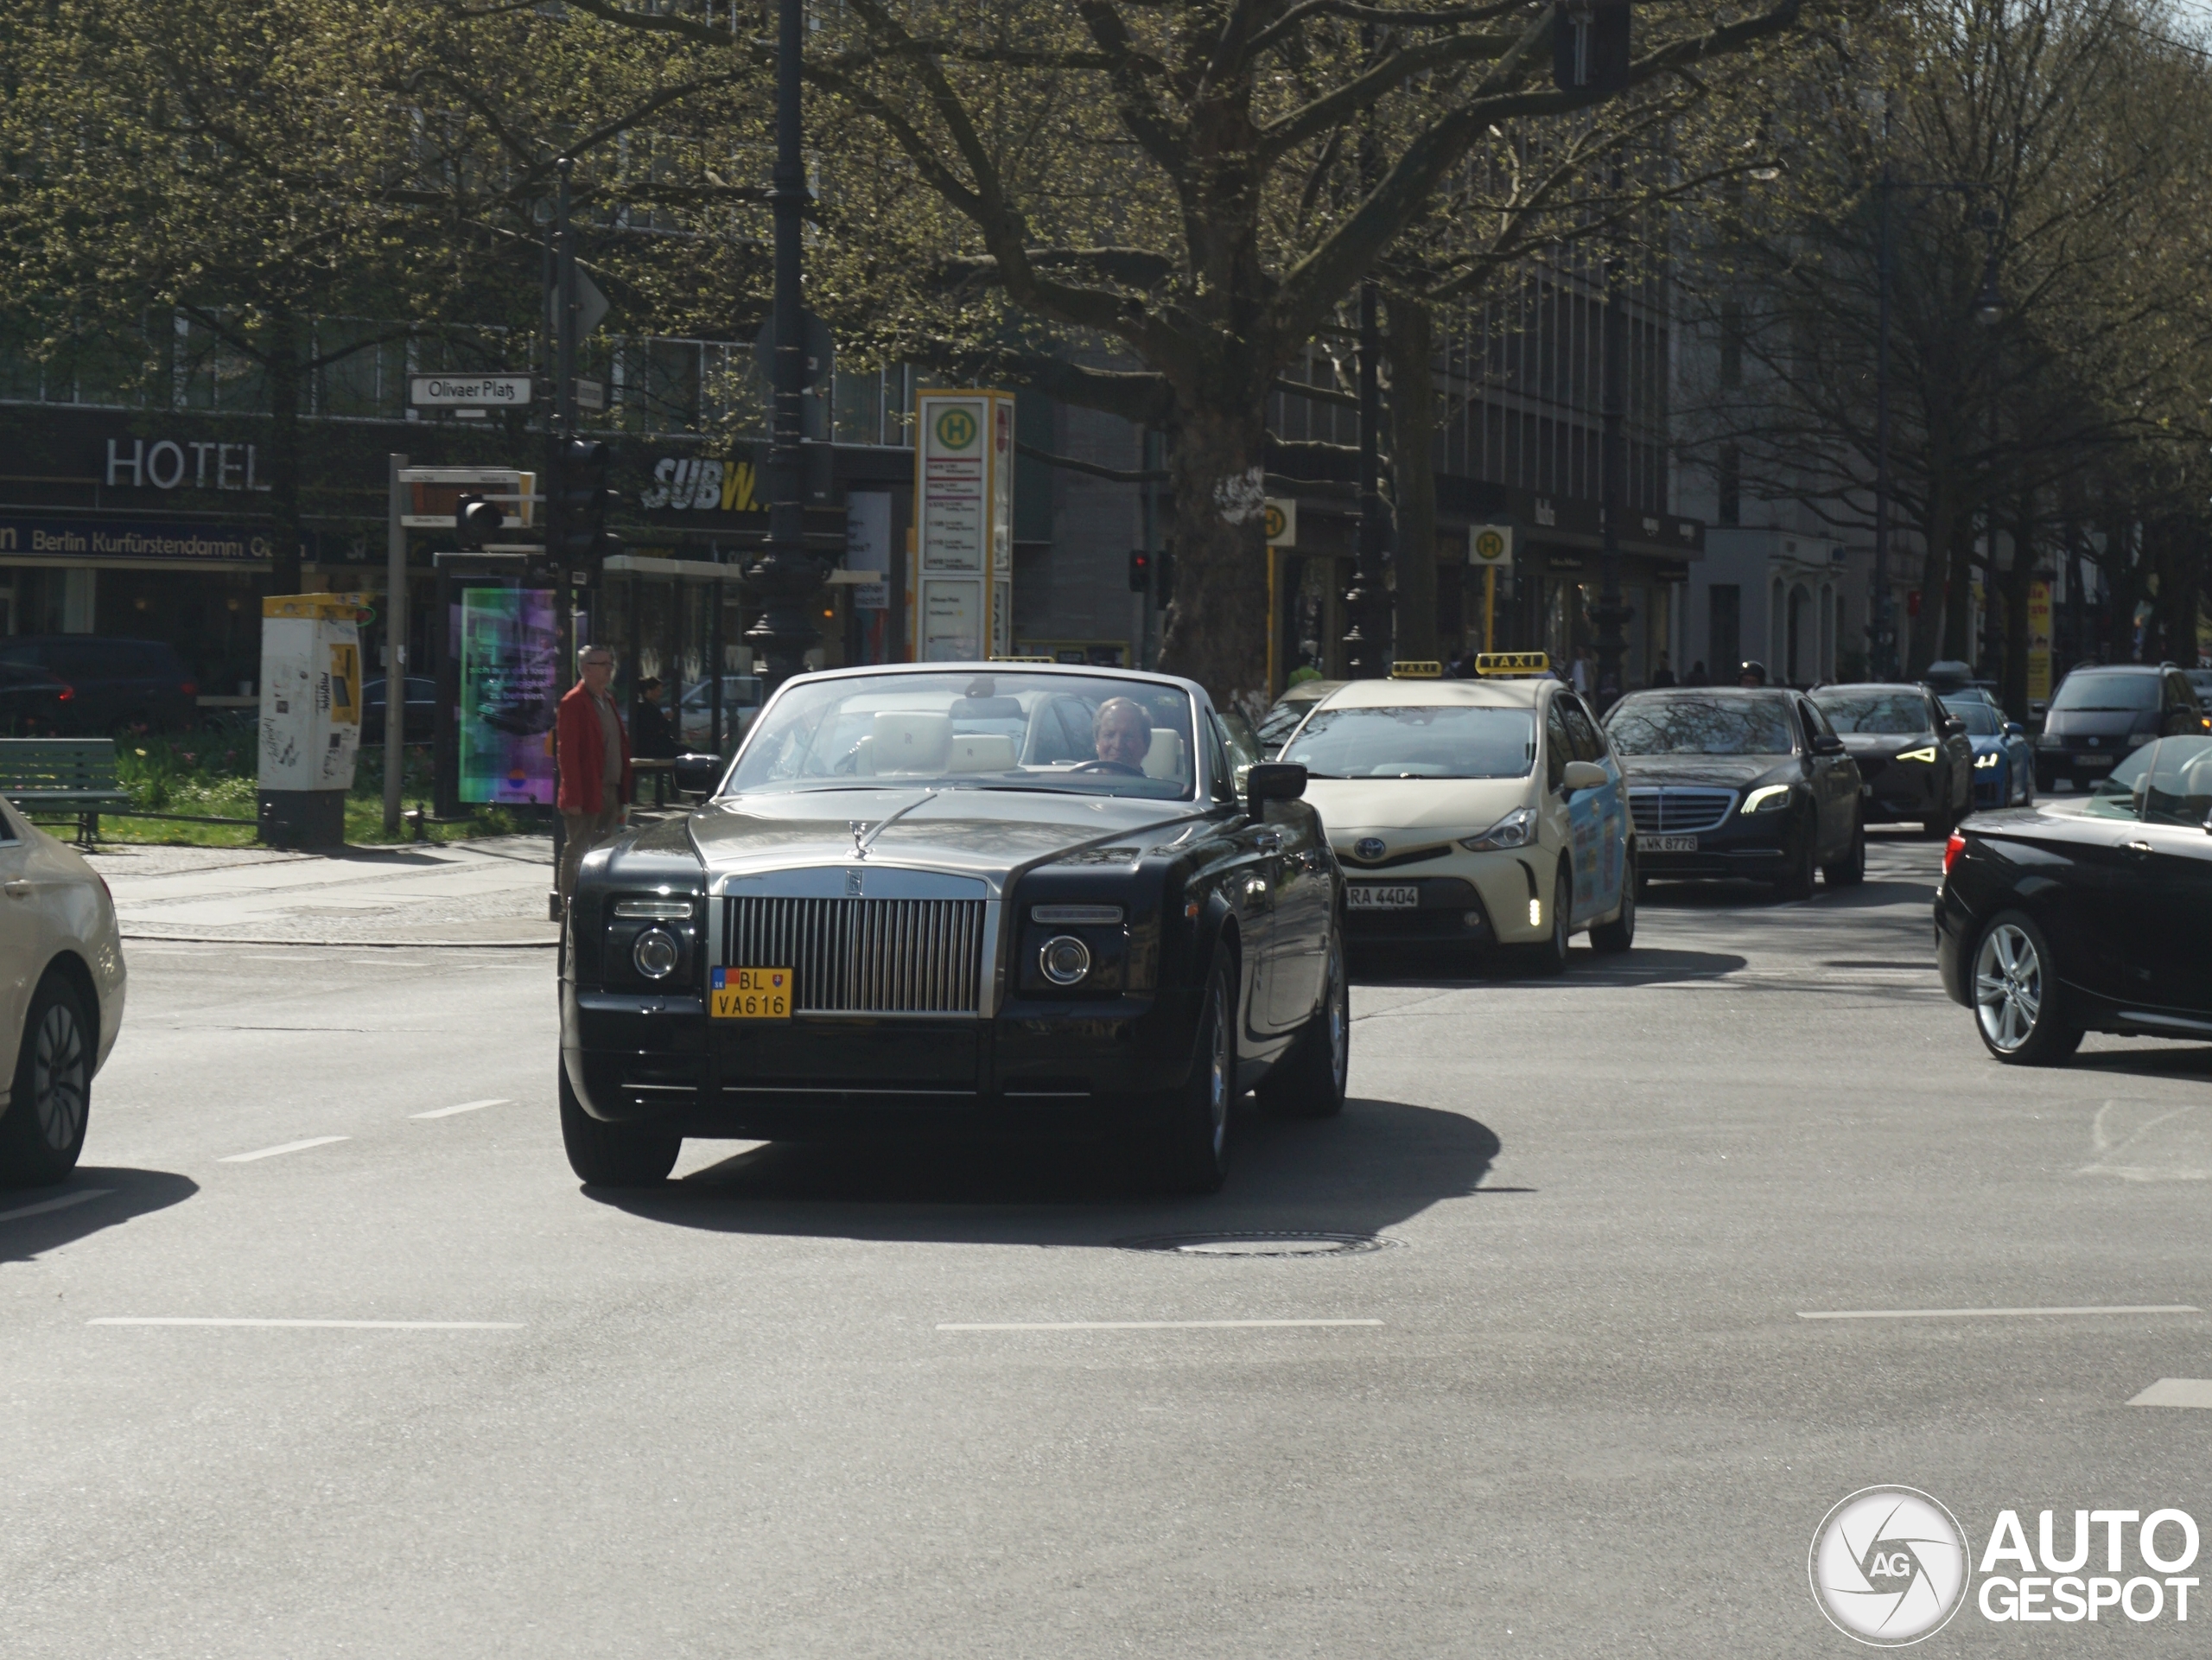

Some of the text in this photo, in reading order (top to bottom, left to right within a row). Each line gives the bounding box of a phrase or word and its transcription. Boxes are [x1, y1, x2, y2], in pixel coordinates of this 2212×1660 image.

[429, 381, 515, 399] Olivaer Platz
[947, 417, 965, 440] H
[106, 438, 272, 492] HOTEL
[640, 458, 772, 512] SUBW
[32, 529, 86, 554] Berlin
[92, 531, 244, 558] Kurfürstendamm
[1484, 539, 1497, 550] H
[1400, 664, 1433, 672] TAXI
[1486, 655, 1536, 666] TAXI
[1665, 837, 1695, 849] 8778
[1376, 888, 1415, 905] 4404
[740, 971, 764, 990] BL
[719, 995, 785, 1014] VA616
